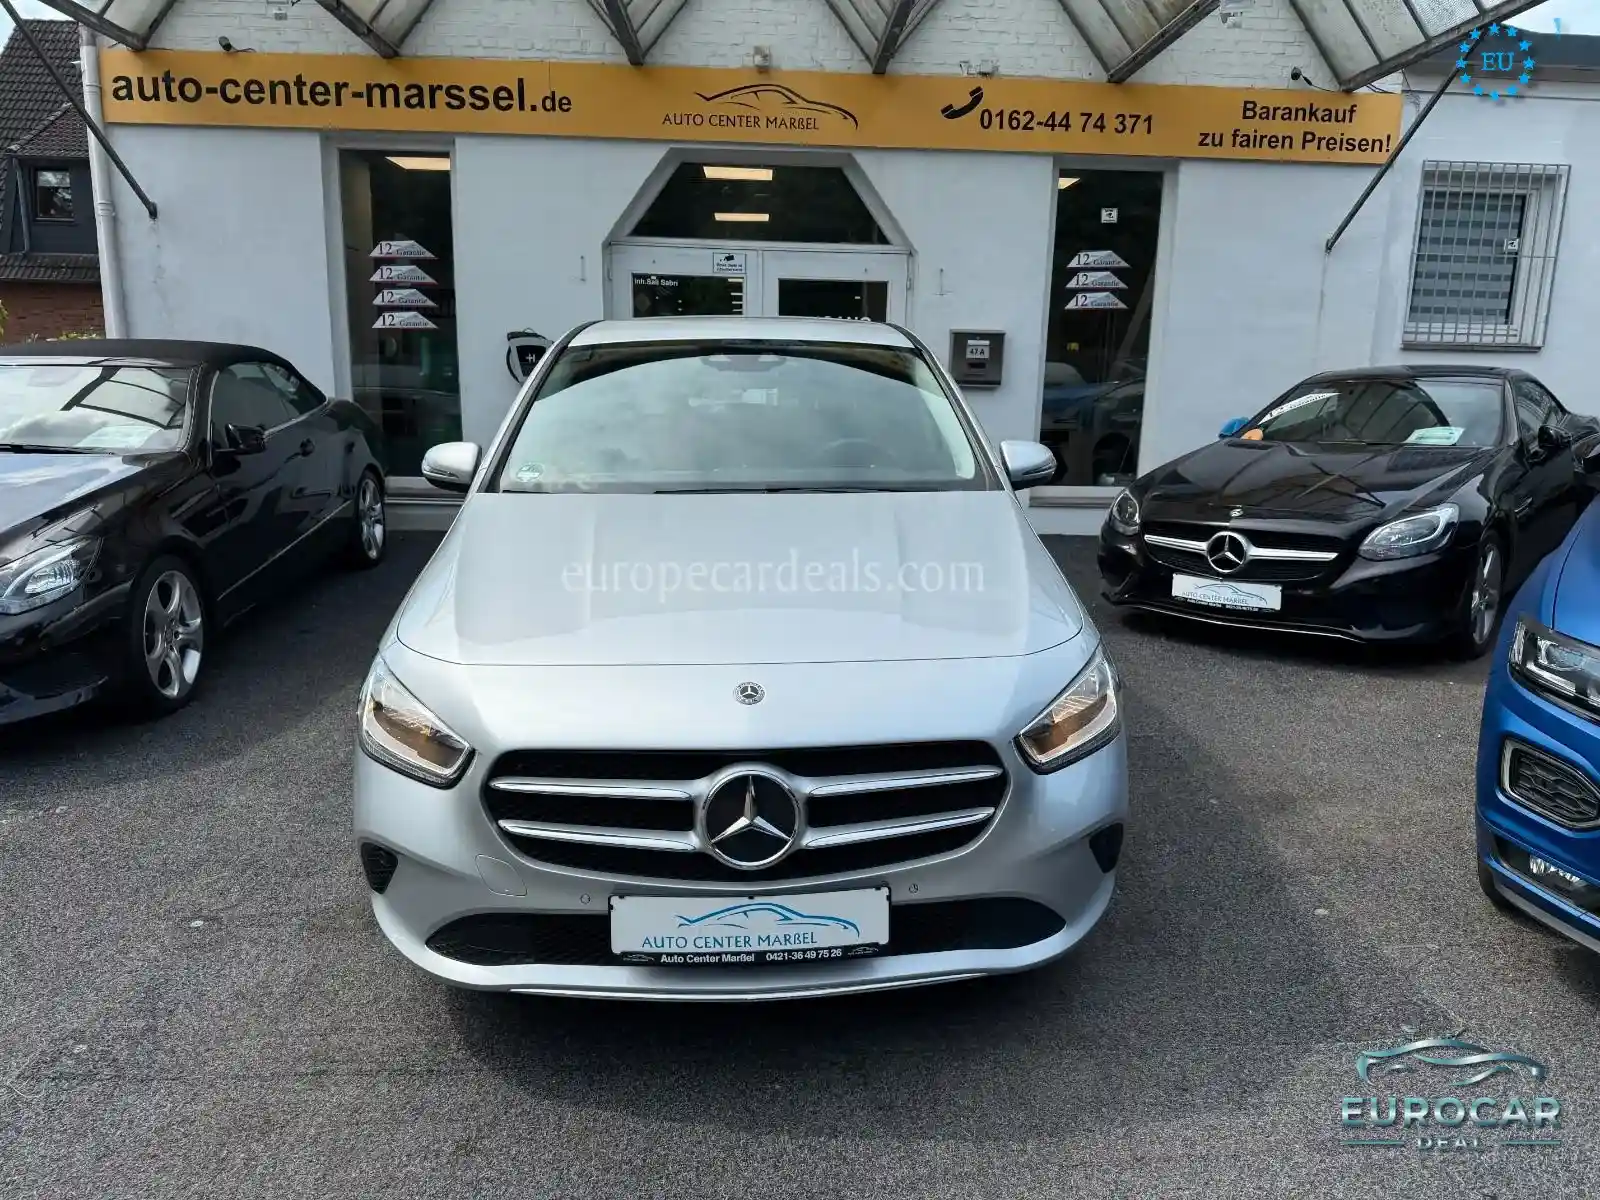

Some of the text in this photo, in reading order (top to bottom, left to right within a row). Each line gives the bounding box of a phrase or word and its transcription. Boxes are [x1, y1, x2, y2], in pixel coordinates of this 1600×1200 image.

[111, 70, 573, 114] auto-center-marssel.de
[1242, 100, 1357, 124] Barankauf
[662, 113, 704, 127] AUTO
[708, 113, 761, 129] CENTER
[980, 108, 1154, 135] 0162-44 74 371
[1198, 129, 1391, 154] zu fairen Preisen!
[378, 242, 393, 255] 12
[1076, 253, 1090, 266] 12
[379, 267, 394, 280] 12
[1075, 273, 1089, 286] 12
[381, 290, 396, 303] 12
[1074, 294, 1089, 307] 12
[382, 313, 397, 327] 12
[641, 936, 688, 949] AUTO
[692, 935, 752, 949] CENTER
[660, 954, 685, 964] Auto
[686, 953, 720, 964] Center
[766, 951, 804, 962] 0421-36
[805, 951, 817, 960] 49
[818, 950, 831, 960] 75
[832, 949, 842, 958] 26
